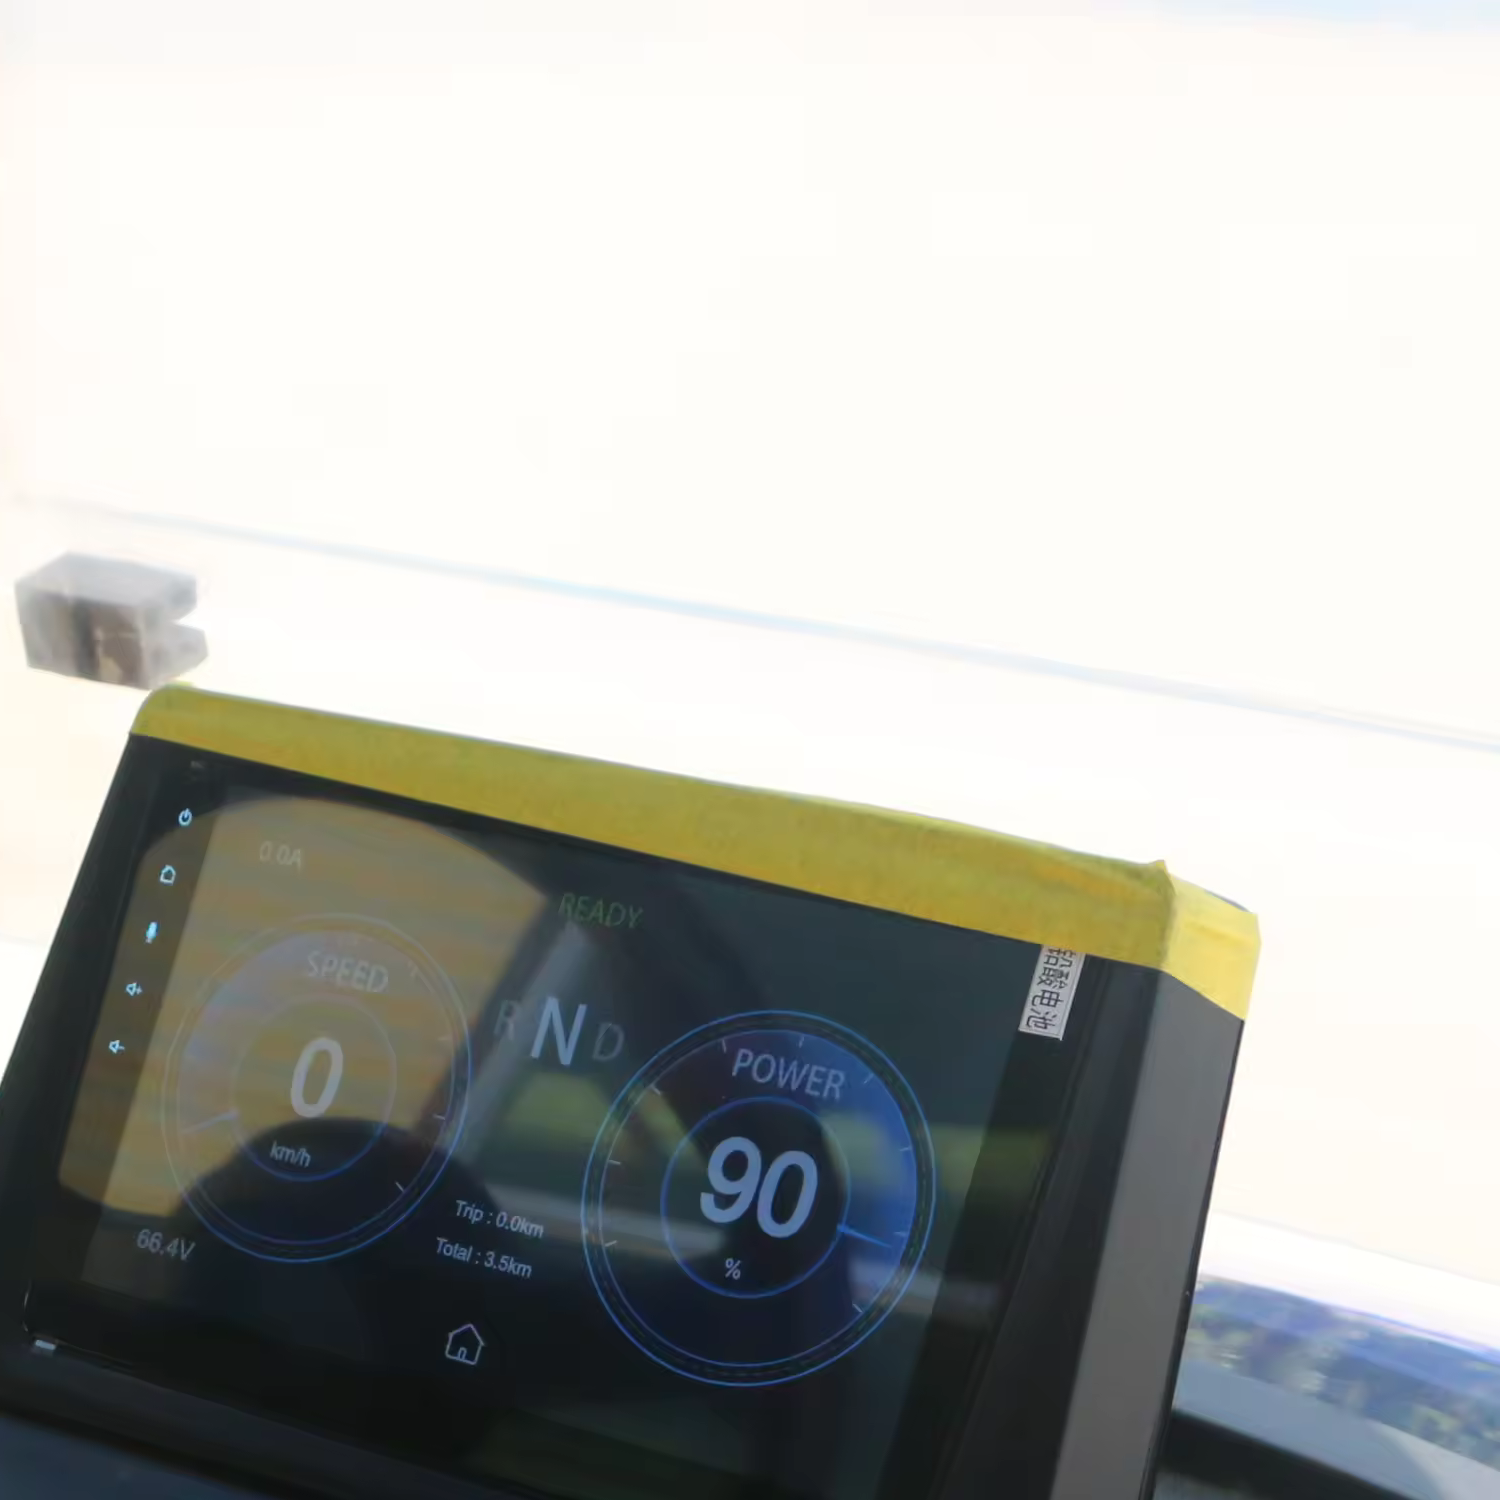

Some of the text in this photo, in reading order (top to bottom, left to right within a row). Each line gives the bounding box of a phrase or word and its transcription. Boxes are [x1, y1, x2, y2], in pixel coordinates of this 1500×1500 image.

[557, 891, 645, 929] READY
[307, 949, 389, 993] SPEED
[530, 996, 588, 1067] N
[592, 1021, 626, 1062] D
[290, 1036, 344, 1118] 0
[731, 1048, 846, 1101] POWER
[269, 1140, 312, 1169] km/h
[700, 1136, 819, 1240] 90
[455, 1199, 485, 1225] Trip
[495, 1211, 545, 1239] 0.0km
[135, 1228, 197, 1262] 66.4V
[436, 1236, 474, 1263] Total
[484, 1250, 533, 1279] 3.5km
